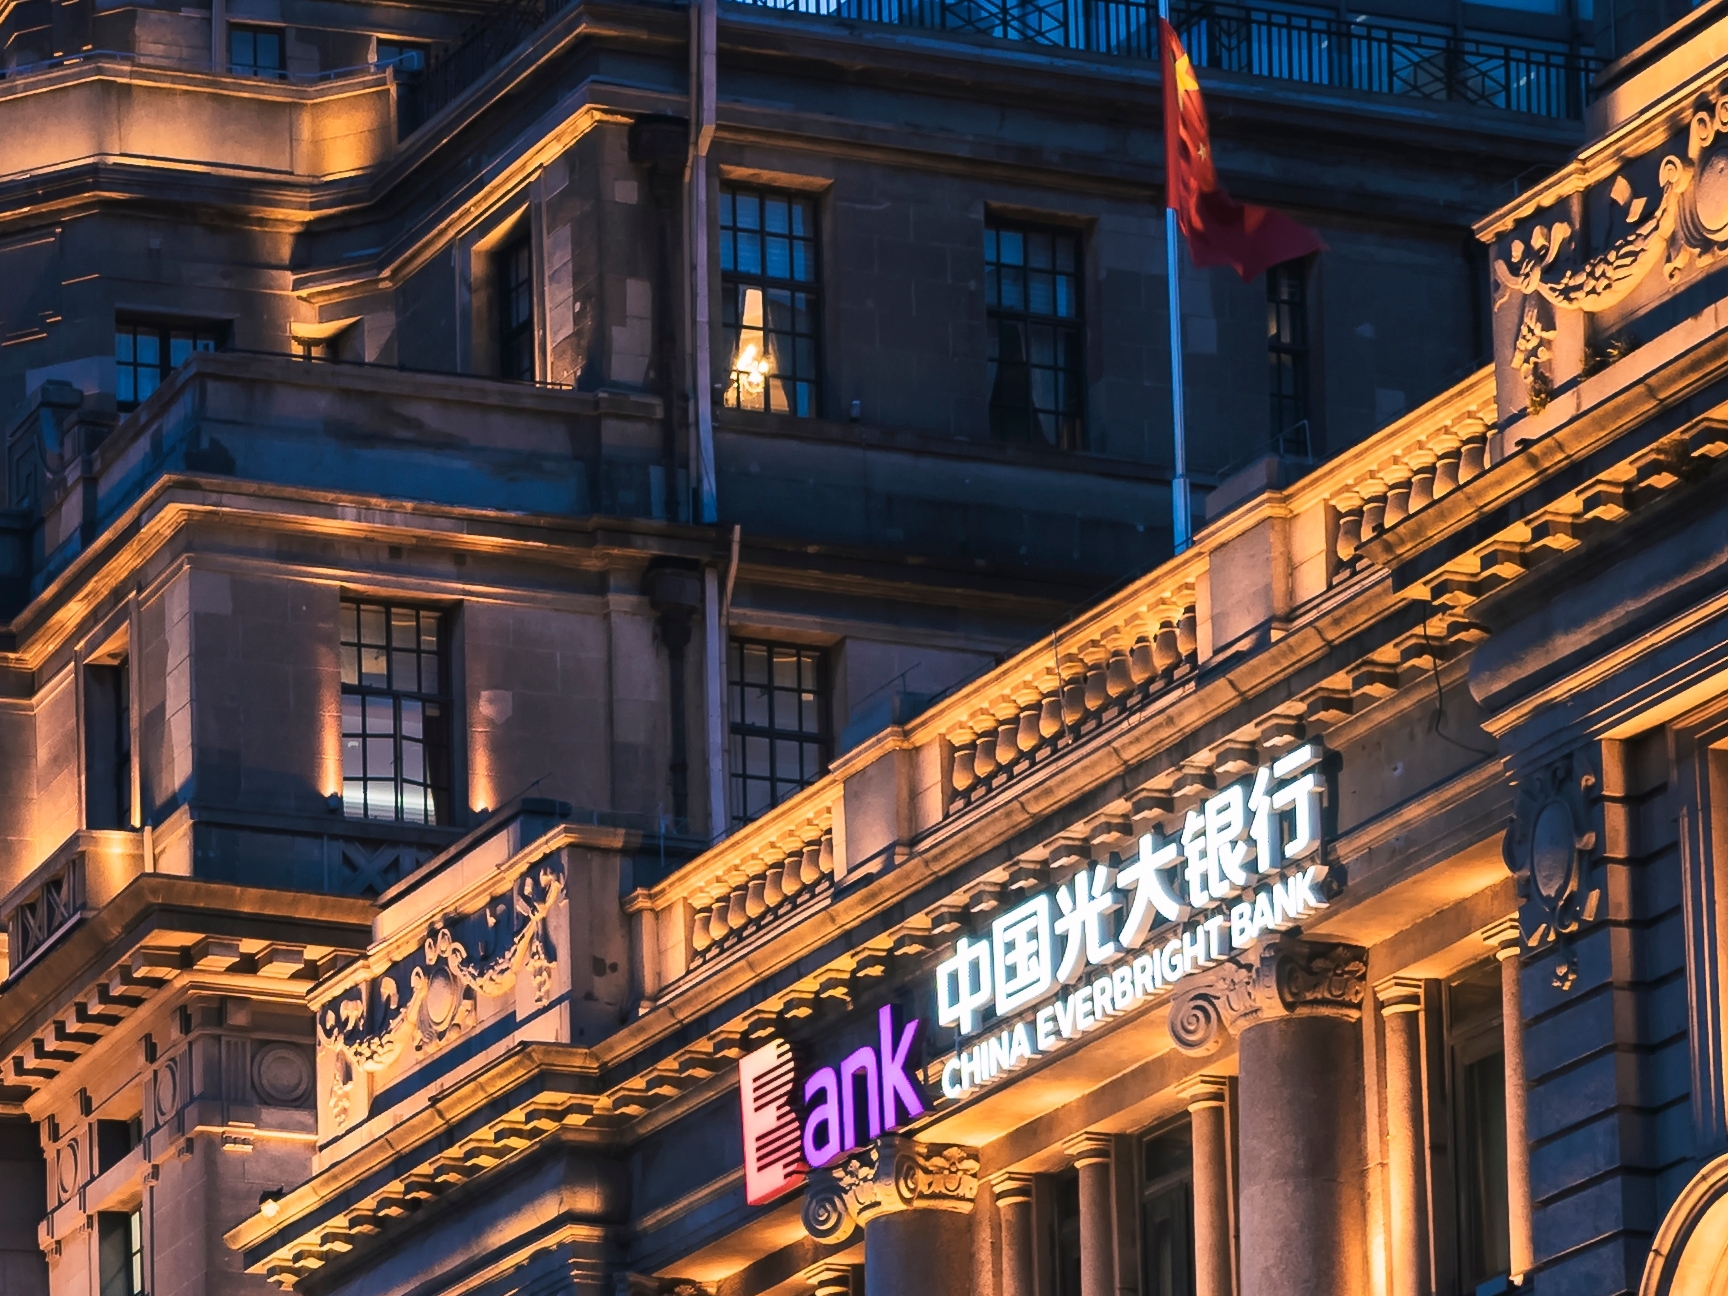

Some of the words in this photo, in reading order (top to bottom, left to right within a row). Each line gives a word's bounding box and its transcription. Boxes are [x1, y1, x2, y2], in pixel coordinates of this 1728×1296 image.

[935, 743, 1324, 1036] 中国光大银行
[941, 1030, 1036, 1100] CHINA
[1036, 918, 1231, 1052] EVERBRIGHT
[1230, 865, 1330, 950] BANK
